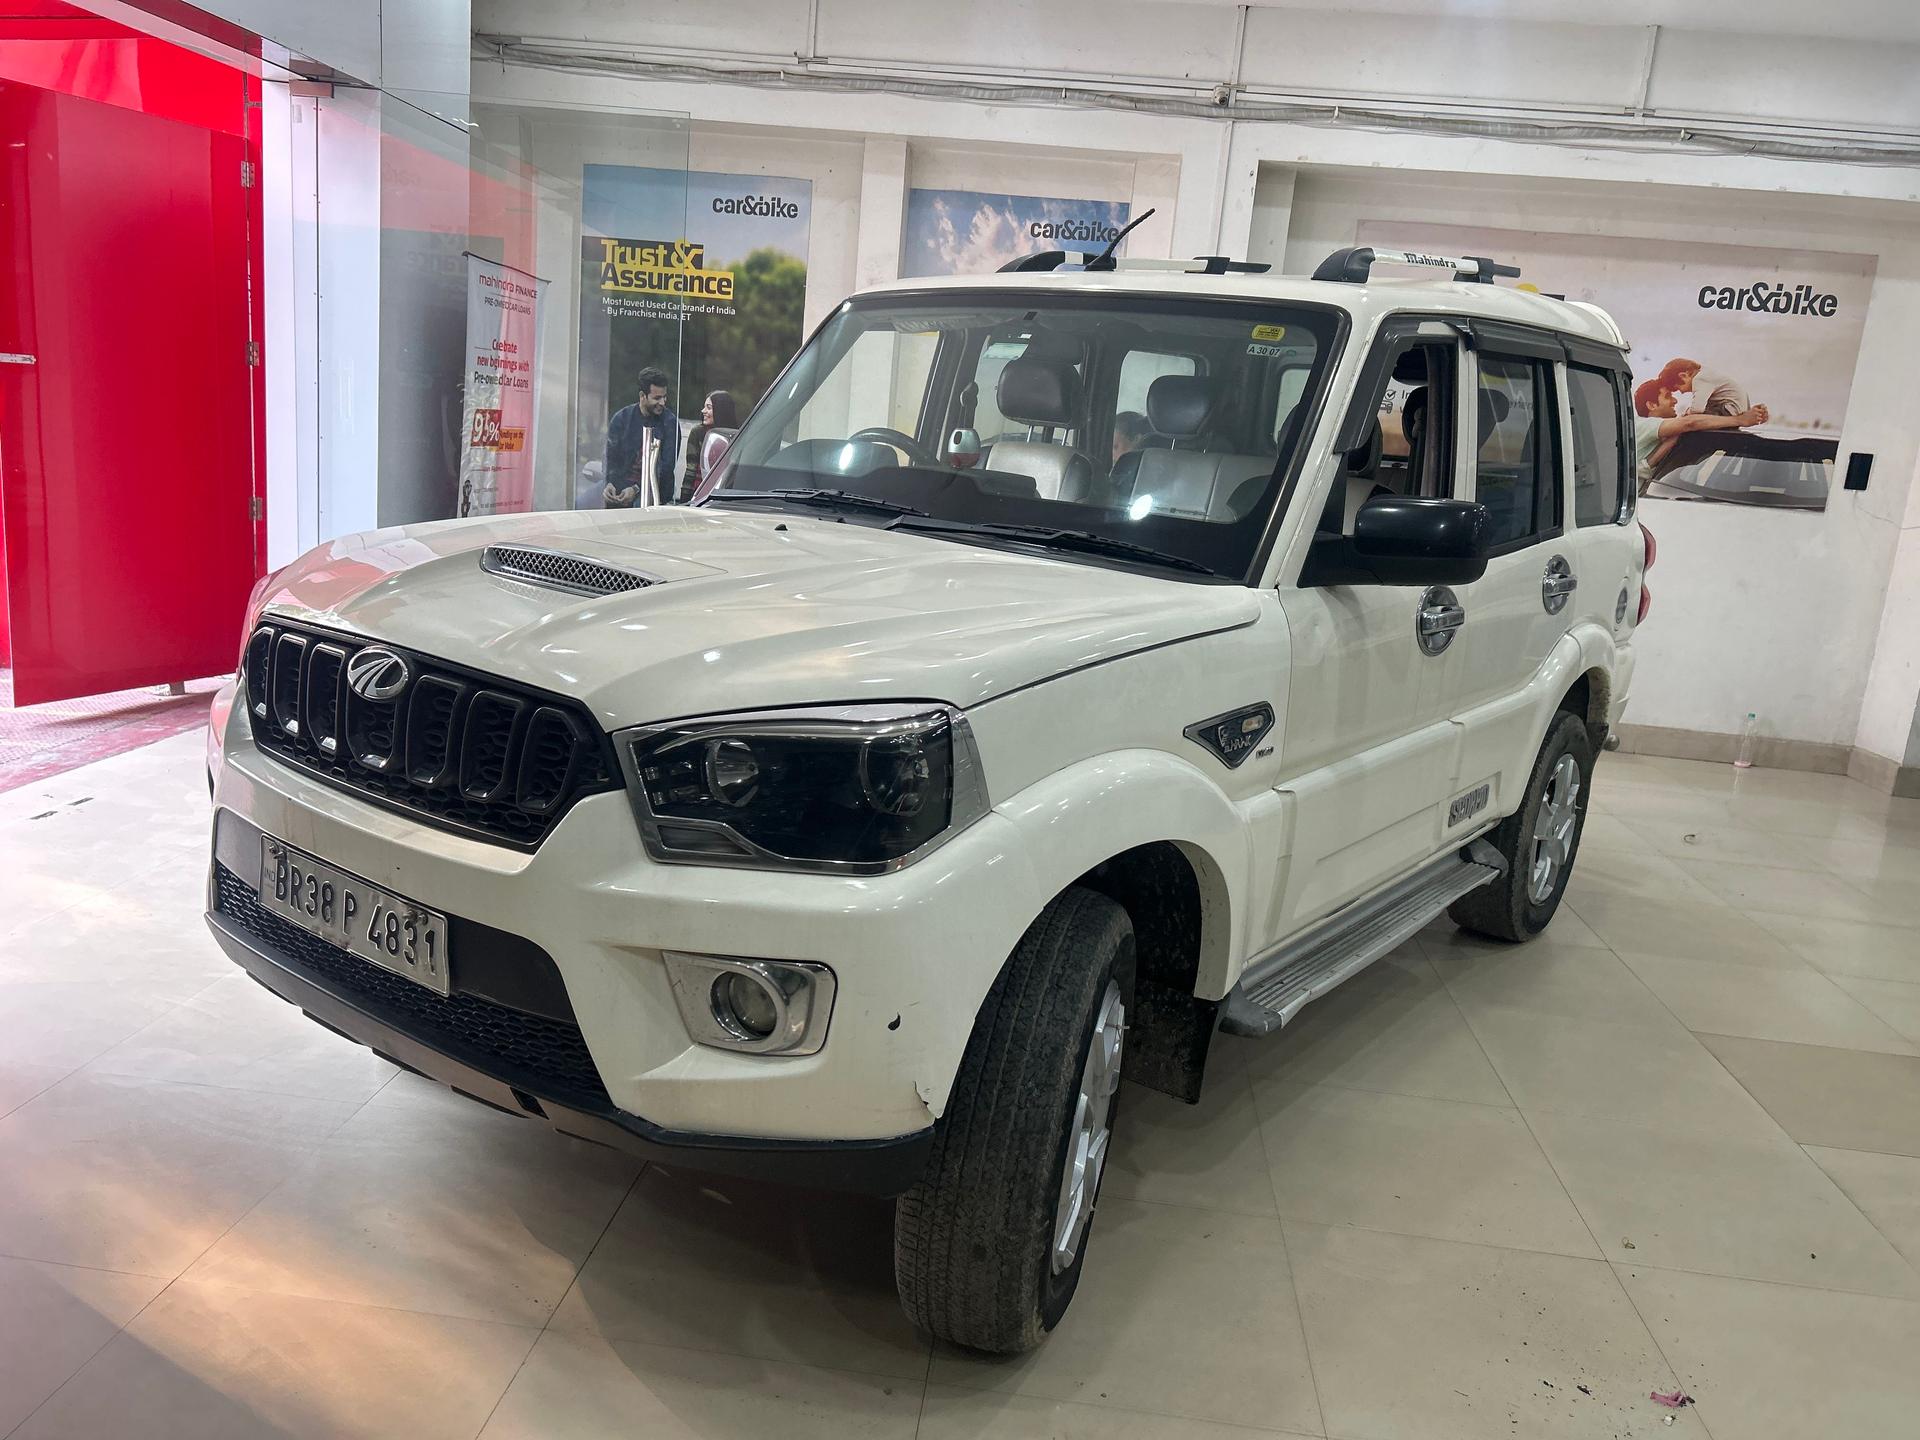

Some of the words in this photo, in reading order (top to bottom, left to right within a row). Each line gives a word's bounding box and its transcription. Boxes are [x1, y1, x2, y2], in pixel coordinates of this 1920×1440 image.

[712, 195, 799, 219] car&bike
[1030, 219, 1120, 243] car&bike
[601, 239, 667, 267] Trust
[671, 237, 704, 271] &
[1403, 252, 1457, 269] Mahindra
[479, 274, 515, 293] mahindra
[515, 284, 538, 299] FINANCE
[601, 262, 732, 296] Assurance
[518, 304, 531, 315] LOANS
[602, 296, 623, 306] Most
[623, 298, 645, 308] loved
[646, 300, 666, 310] Used
[667, 302, 681, 311] Car
[682, 302, 705, 313] brand
[706, 305, 715, 314] of
[716, 306, 736, 316] India
[1697, 281, 1838, 318] car&bike
[607, 306, 618, 317] By
[619, 308, 657, 318] Franchise
[658, 311, 681, 321] India,
[681, 313, 692, 321] ET
[492, 338, 518, 354] Cebrate
[1248, 346, 1255, 354] A
[476, 355, 489, 366] new
[489, 355, 518, 373] bginnings
[518, 359, 530, 373] with
[513, 375, 529, 388] Loans
[275, 857, 335, 925] BR38
[342, 888, 358, 936] P
[366, 903, 437, 976] 4831
